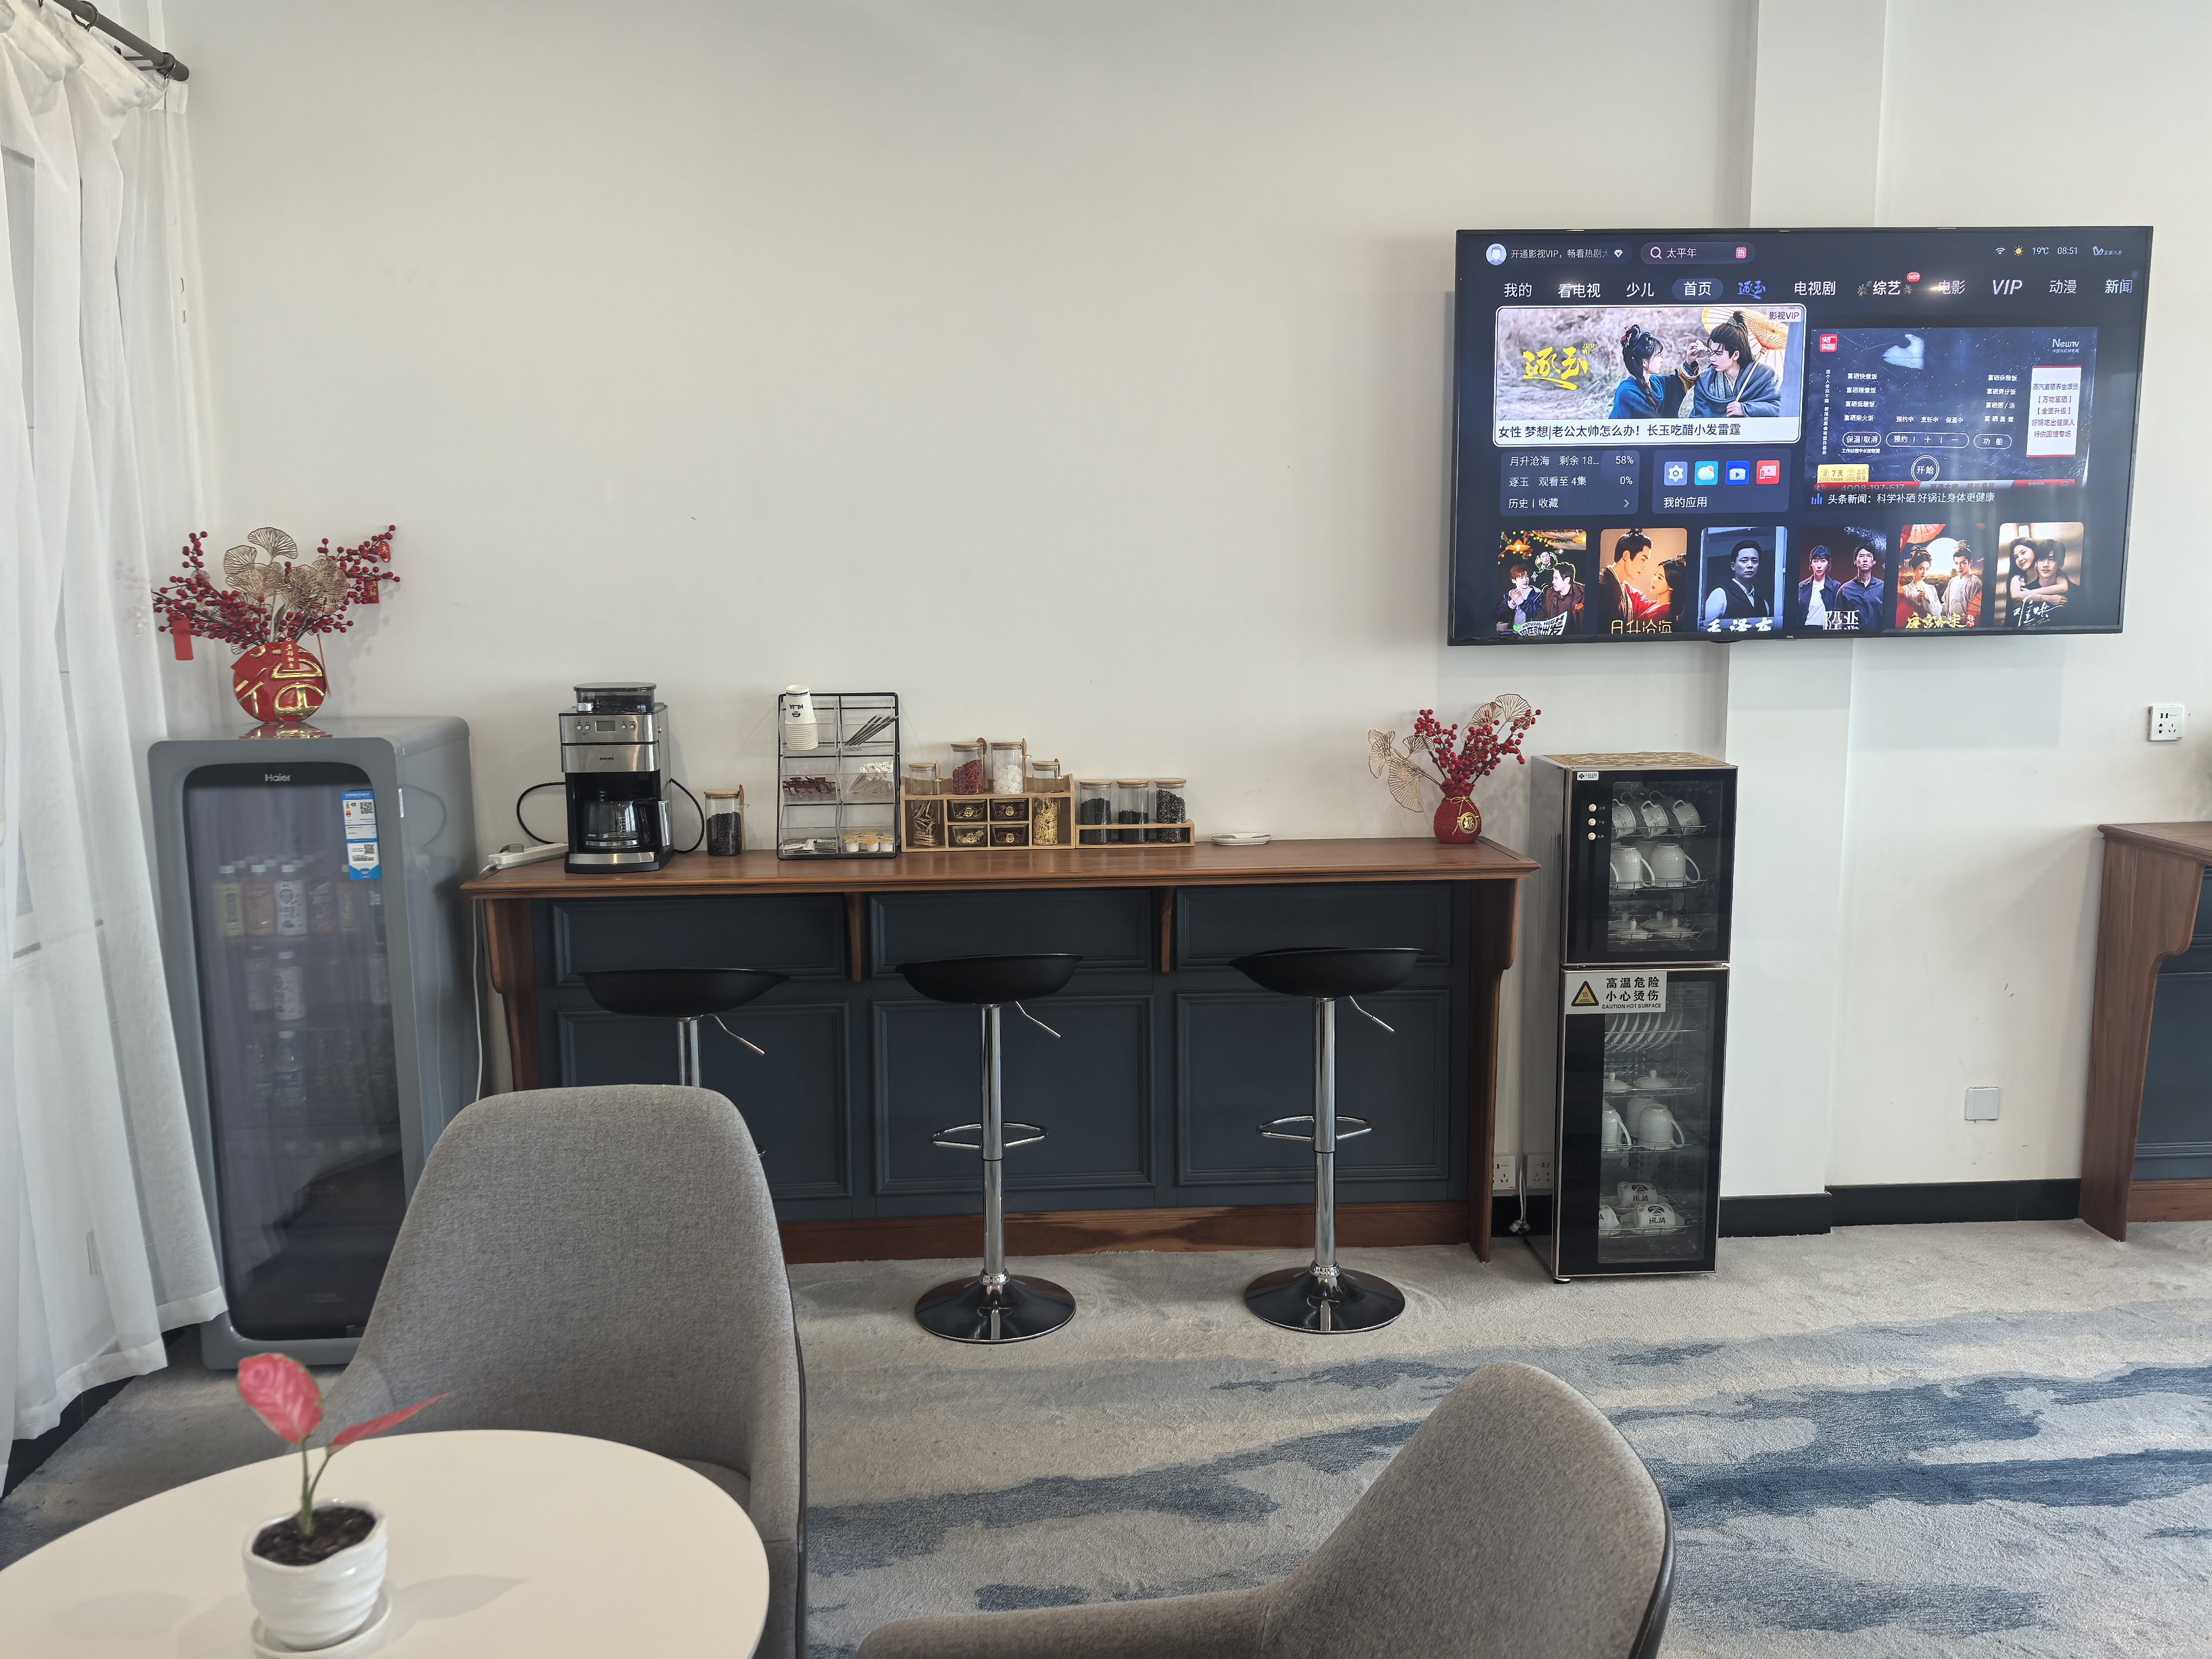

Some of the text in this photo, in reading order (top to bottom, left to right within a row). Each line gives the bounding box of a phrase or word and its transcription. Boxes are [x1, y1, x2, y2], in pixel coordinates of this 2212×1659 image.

[1667, 248, 1697, 258] 太平年
[1737, 248, 1745, 258] 热
[2057, 247, 2078, 255] 08:51
[1503, 282, 1533, 298] 我的
[1557, 282, 1601, 299] 看电视
[1626, 282, 1655, 298] 少儿
[1683, 281, 1712, 296] 首页
[1794, 280, 1836, 296] 电视剧
[1872, 280, 1901, 295] 综艺
[1938, 280, 1966, 295] 电影
[1992, 279, 2023, 295] VIP
[2049, 279, 2077, 294] 动漫
[2104, 279, 2133, 294] 新闻
[1769, 311, 1800, 320] 影视VIP
[1498, 426, 1522, 438] 女性
[1982, 437, 2004, 446] 功能
[1509, 455, 1550, 467] 月升沧海
[1559, 455, 1580, 466] 剩余
[1615, 455, 1634, 466] 58%
[1916, 466, 1934, 475] 开始
[1509, 476, 1633, 487] 逐玉 观看至 4集 0%
[1508, 497, 1559, 509] 历史 收藏
[1663, 496, 1708, 509] 我的应用
[1827, 491, 1995, 504] 头条新闻：科学补硒 好锅让身体更健康
[1543, 615, 1565, 626] HIGH
[265, 773, 291, 781] Haier
[1606, 976, 1660, 989] 高温危险
[1606, 990, 1659, 1002] 小心烫伤
